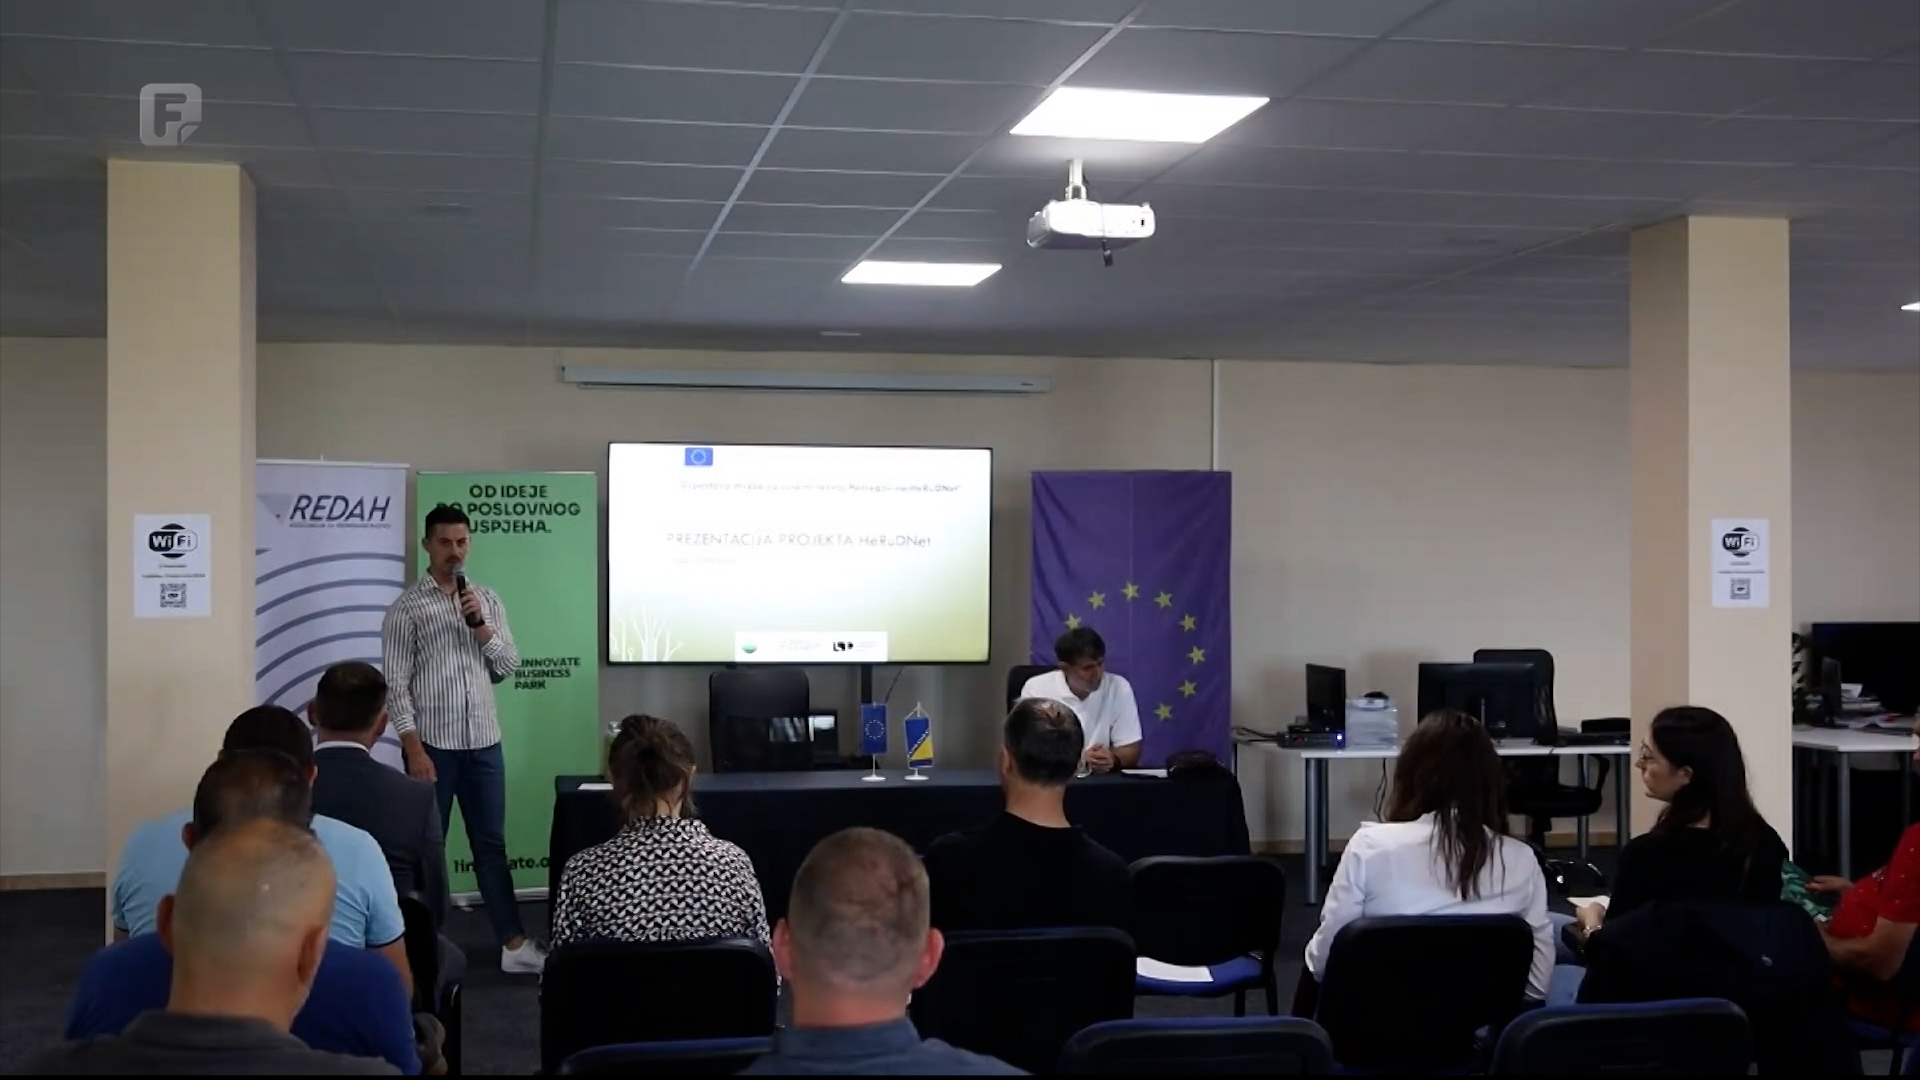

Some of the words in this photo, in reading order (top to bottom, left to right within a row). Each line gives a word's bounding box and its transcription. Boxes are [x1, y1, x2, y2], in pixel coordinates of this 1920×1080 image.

[469, 484, 497, 498] OD
[501, 484, 548, 498] IDEJE
[289, 494, 391, 521] REDAH
[467, 502, 581, 516] POSLOVNOG
[152, 535, 191, 548] WiFi
[666, 532, 772, 546] PREZENTACIJA
[779, 533, 853, 547] PROJEKTA
[515, 657, 581, 667] INNOVATE
[514, 669, 571, 678] BUSINESS
[514, 681, 546, 690] PARK
